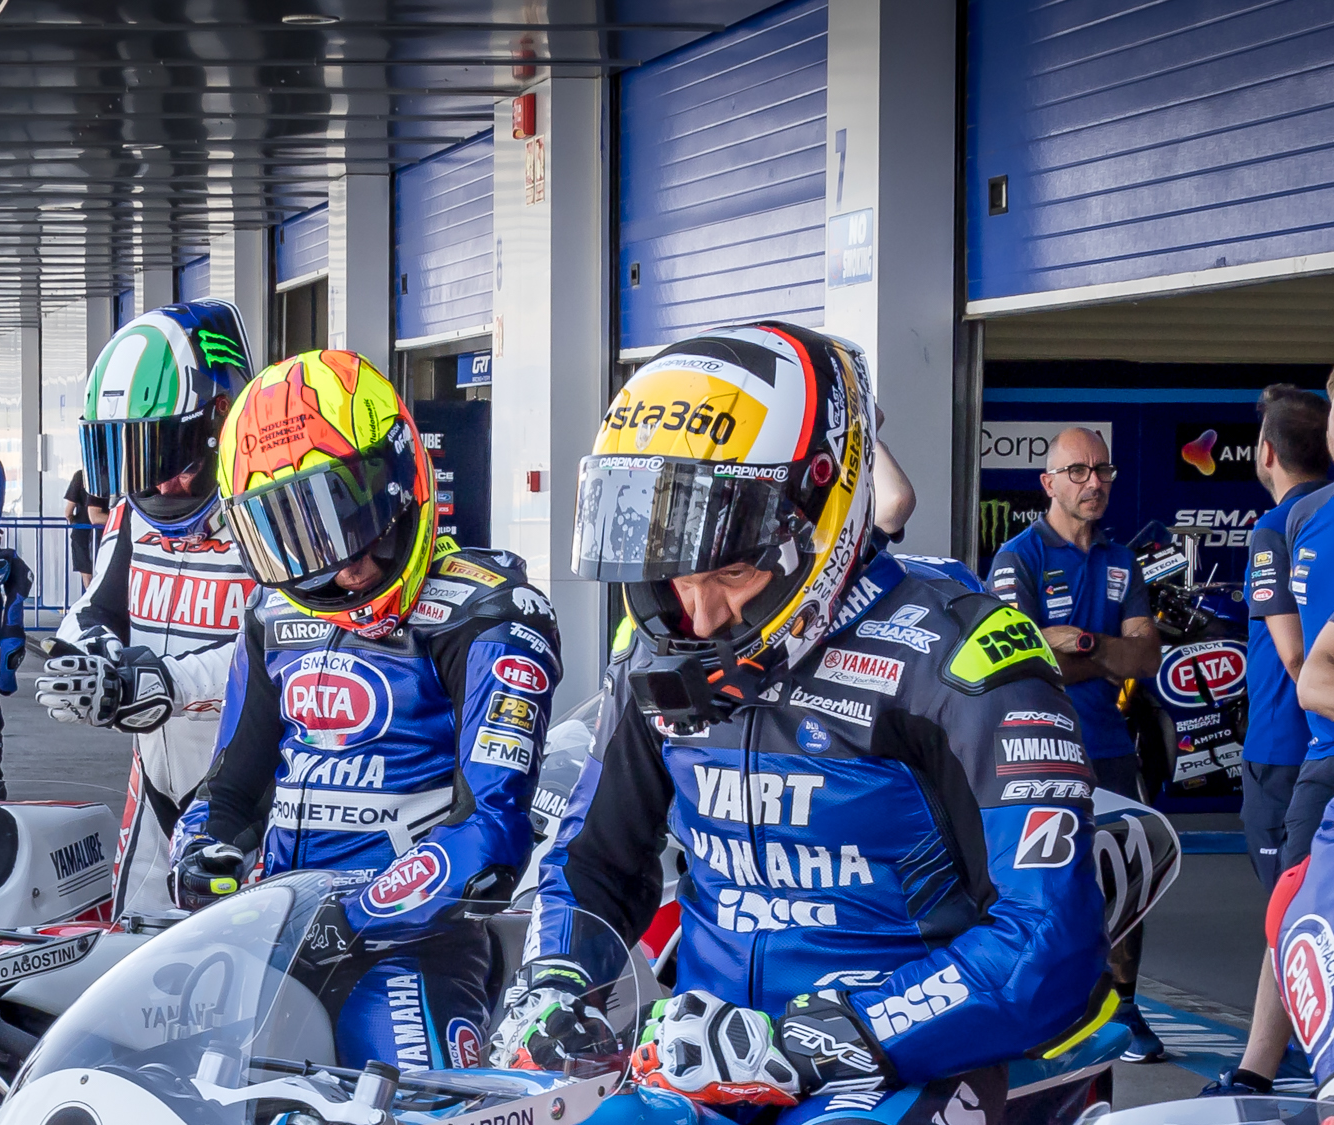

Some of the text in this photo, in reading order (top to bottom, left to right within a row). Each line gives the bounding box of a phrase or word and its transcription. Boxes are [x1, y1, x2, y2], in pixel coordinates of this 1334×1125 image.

[603, 399, 737, 446] sta360
[714, 463, 789, 483] CARPIMOTO
[447, 560, 500, 584] PIRELLI
[129, 571, 248, 630] AMAHA
[859, 620, 932, 650] SHARK
[503, 666, 540, 690] HEL
[841, 652, 899, 682] YAMAHA
[292, 685, 357, 721] PATA
[499, 697, 529, 719] PB
[790, 685, 873, 721] hyperMILL
[1002, 738, 1085, 765] YAMALUBE
[1193, 729, 1232, 746] AMPITO
[486, 742, 531, 767] FMB
[693, 764, 825, 826] YART
[1001, 779, 1092, 800] GYTR
[49, 831, 106, 881] YAMALUBE
[690, 827, 875, 889] YAMAHA
[377, 859, 431, 900] PATA
[10, 945, 76, 976] AGOSTINI
[1286, 946, 1317, 1037] PATA
